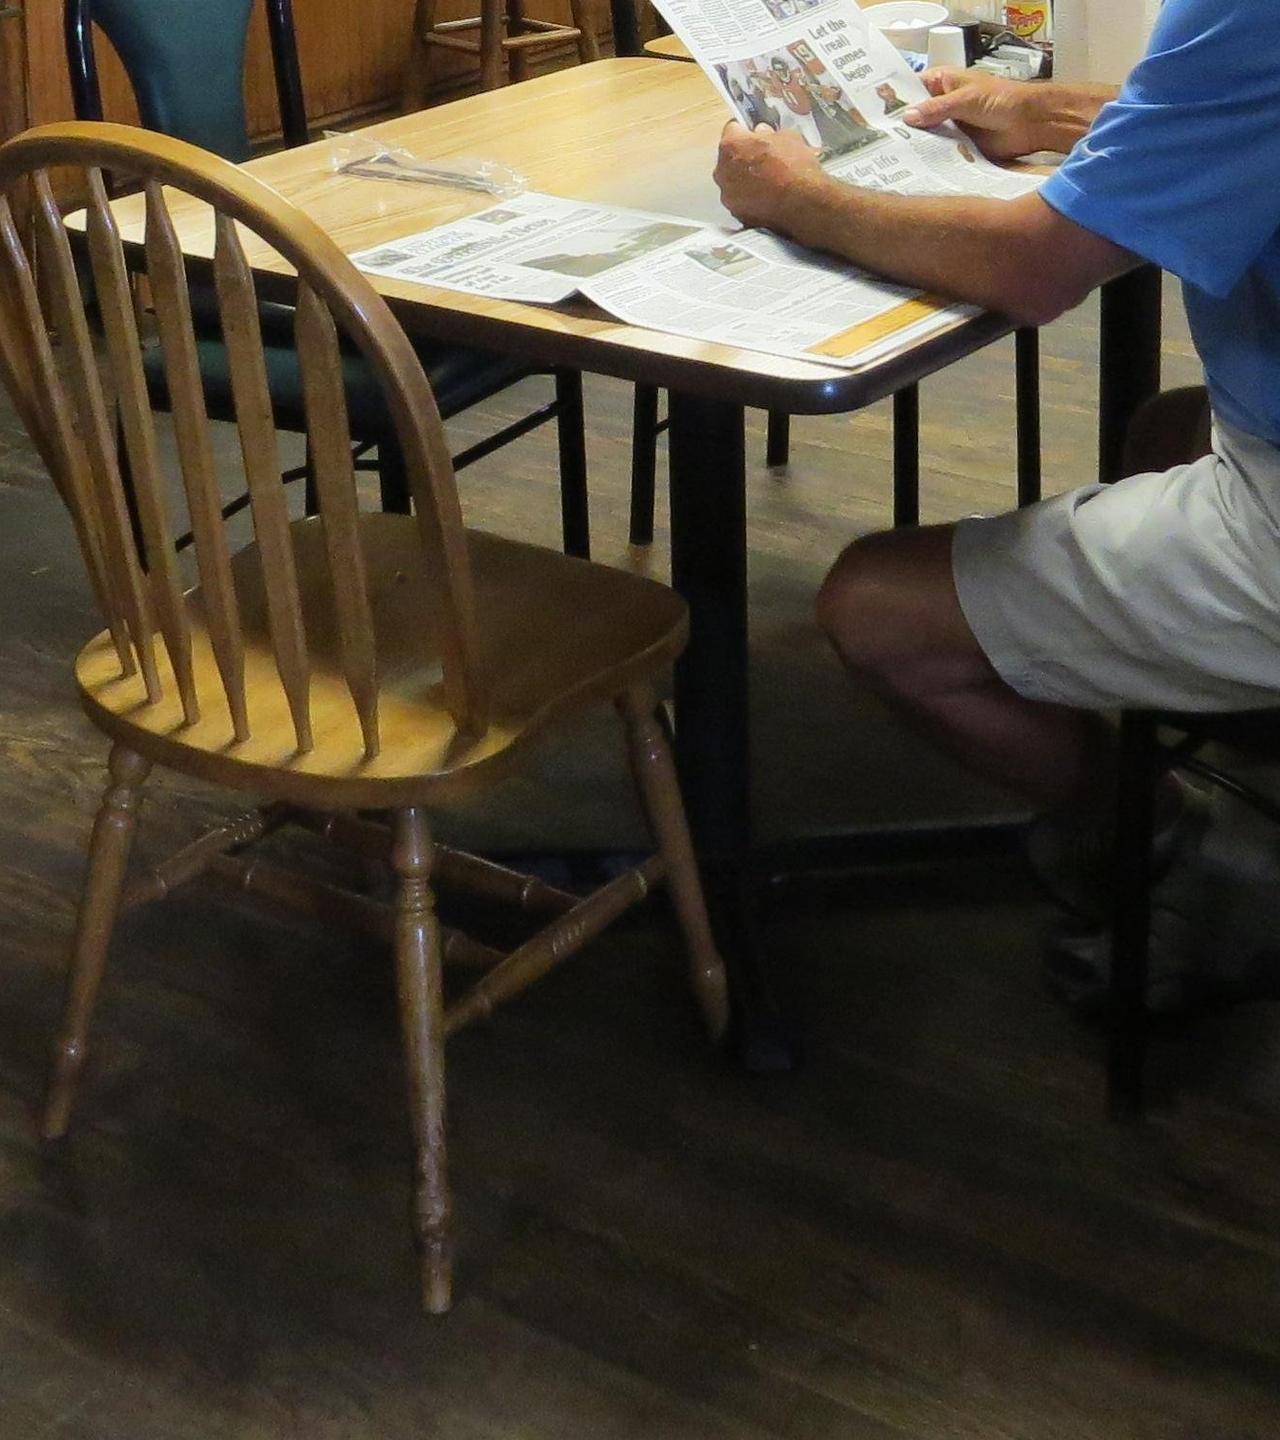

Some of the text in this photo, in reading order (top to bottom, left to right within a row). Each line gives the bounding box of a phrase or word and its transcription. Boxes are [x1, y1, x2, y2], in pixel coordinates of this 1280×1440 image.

[808, 17, 848, 41] Let the
[821, 35, 851, 56] (real)
[832, 45, 867, 71] games
[841, 63, 874, 83] begin
[854, 164, 877, 180] day
[881, 166, 914, 187] Rams
